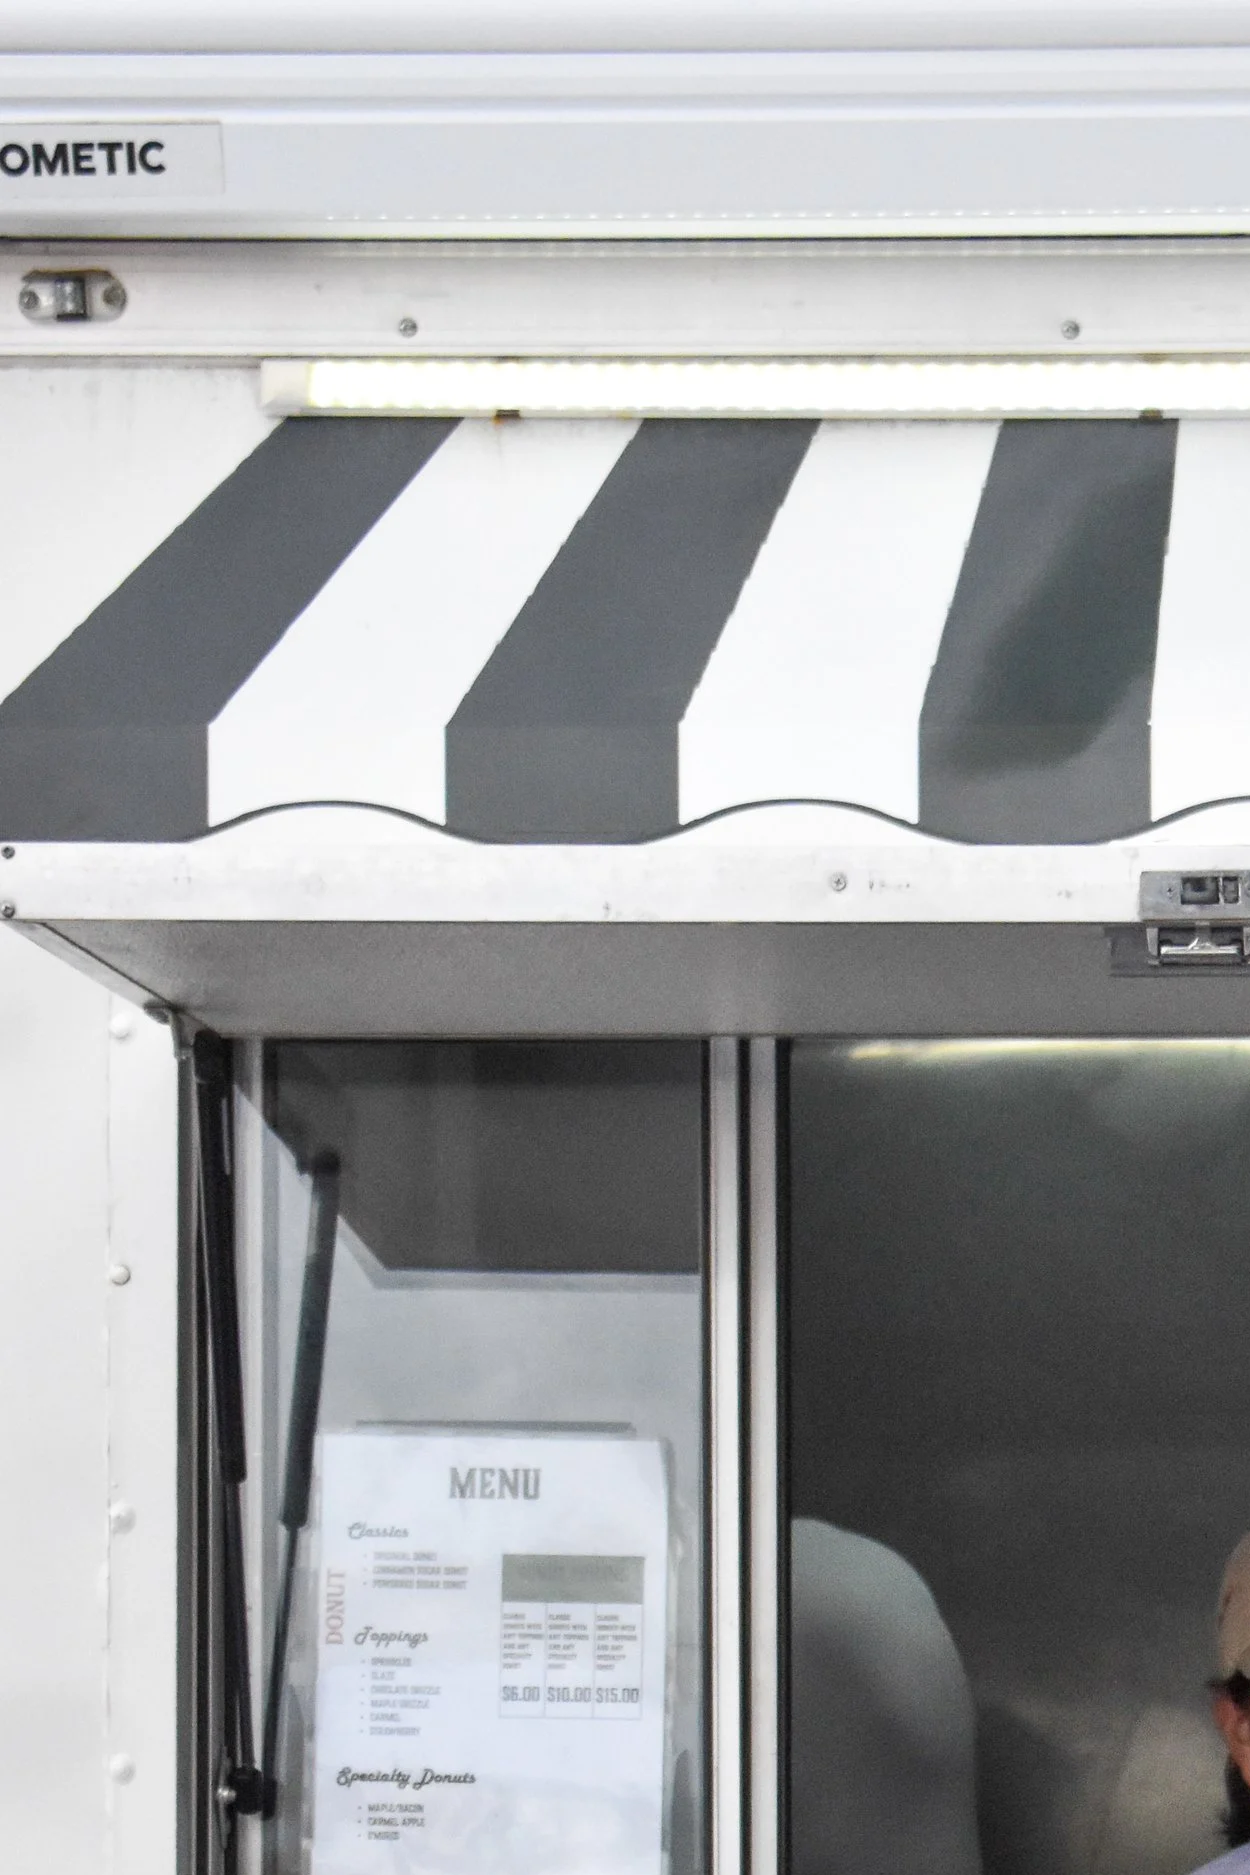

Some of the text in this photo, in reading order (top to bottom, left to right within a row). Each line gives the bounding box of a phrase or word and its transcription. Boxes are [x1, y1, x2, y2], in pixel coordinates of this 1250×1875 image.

[449, 1467, 542, 1500] MENU
[348, 1522, 409, 1540] Classics
[325, 1569, 346, 1645] DONUT
[353, 1626, 429, 1649] Toppings
[502, 1685, 540, 1702] $6.00
[546, 1686, 592, 1703] $10.00
[595, 1688, 640, 1704] $15.00
[336, 1766, 477, 1790] Specialty Donuts
